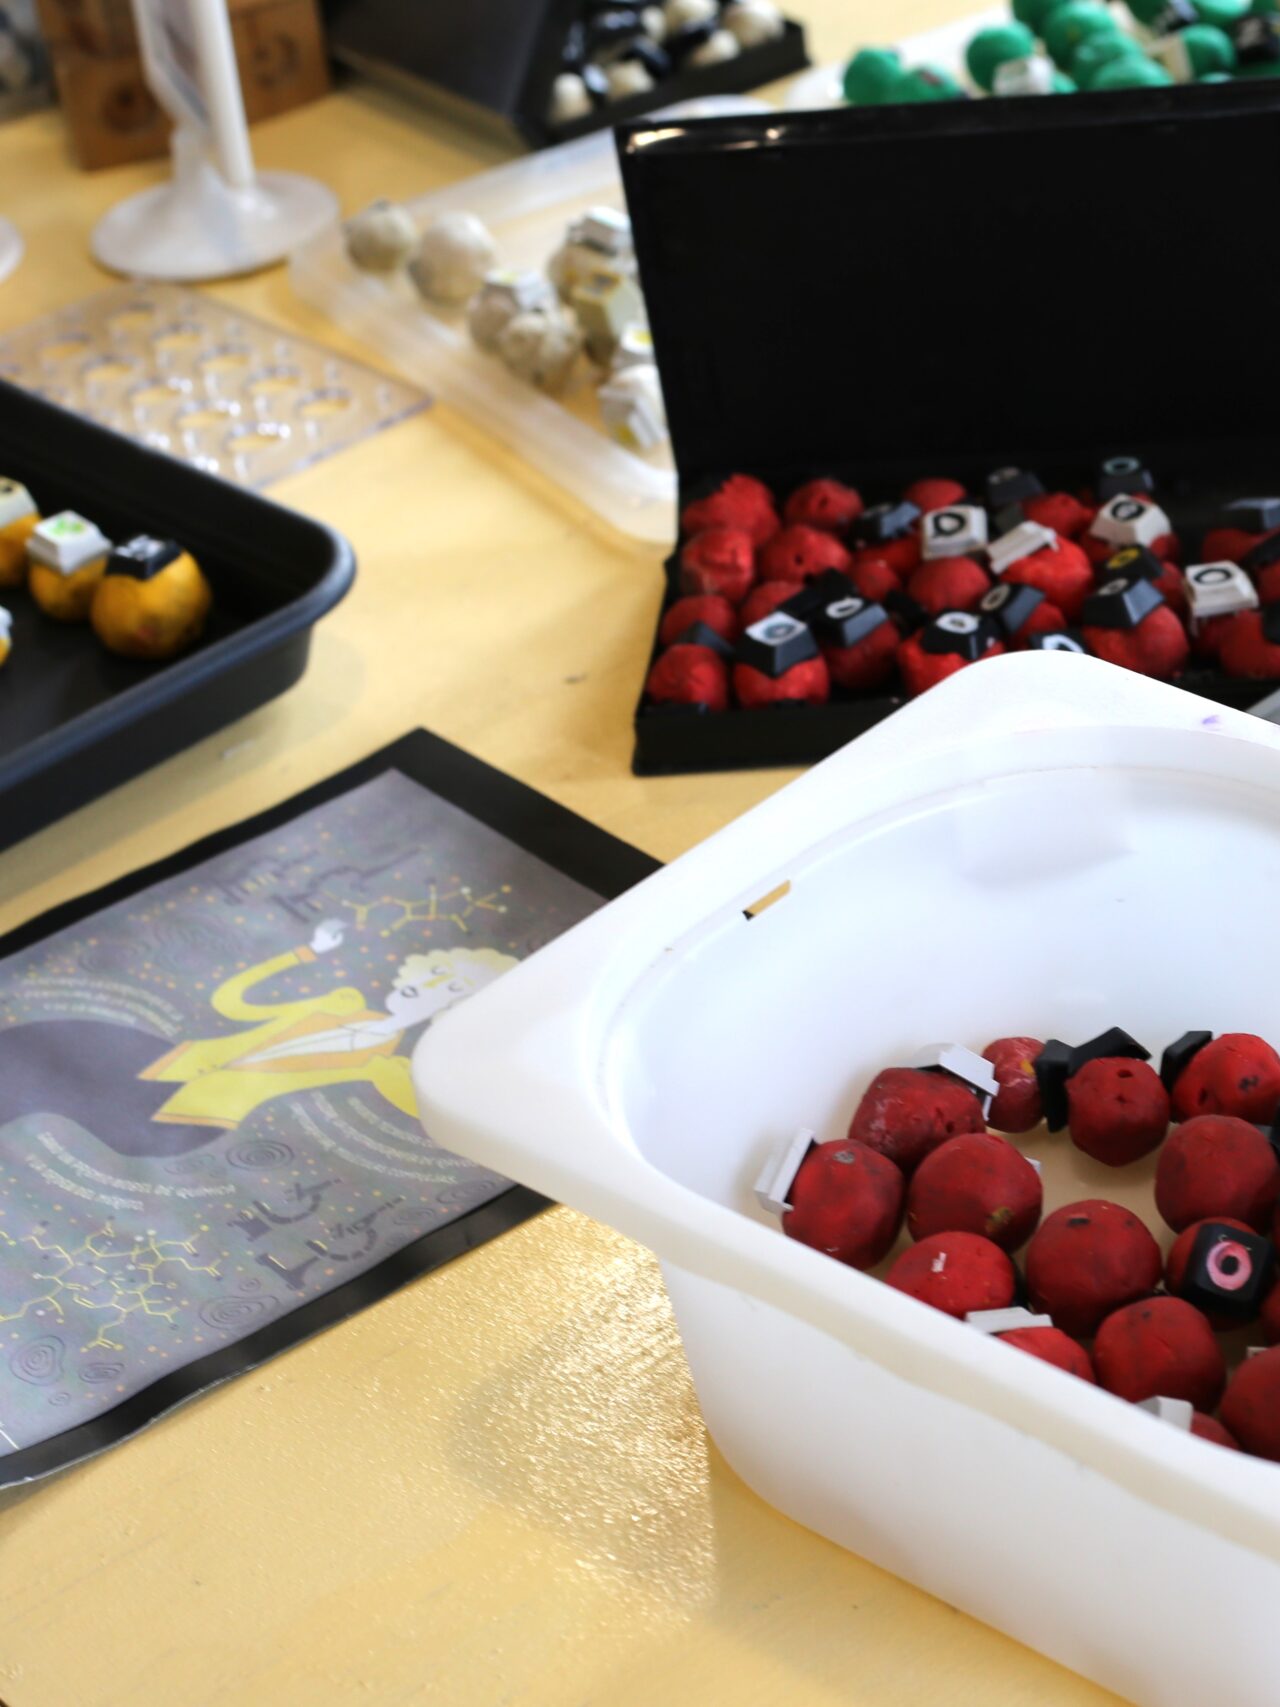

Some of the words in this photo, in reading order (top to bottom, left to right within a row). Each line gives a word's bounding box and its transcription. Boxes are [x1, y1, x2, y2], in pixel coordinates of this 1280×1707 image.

[1111, 500, 1144, 520] O
[1194, 568, 1233, 585] O
[827, 598, 864, 618] O
[1205, 1239, 1253, 1291] O
